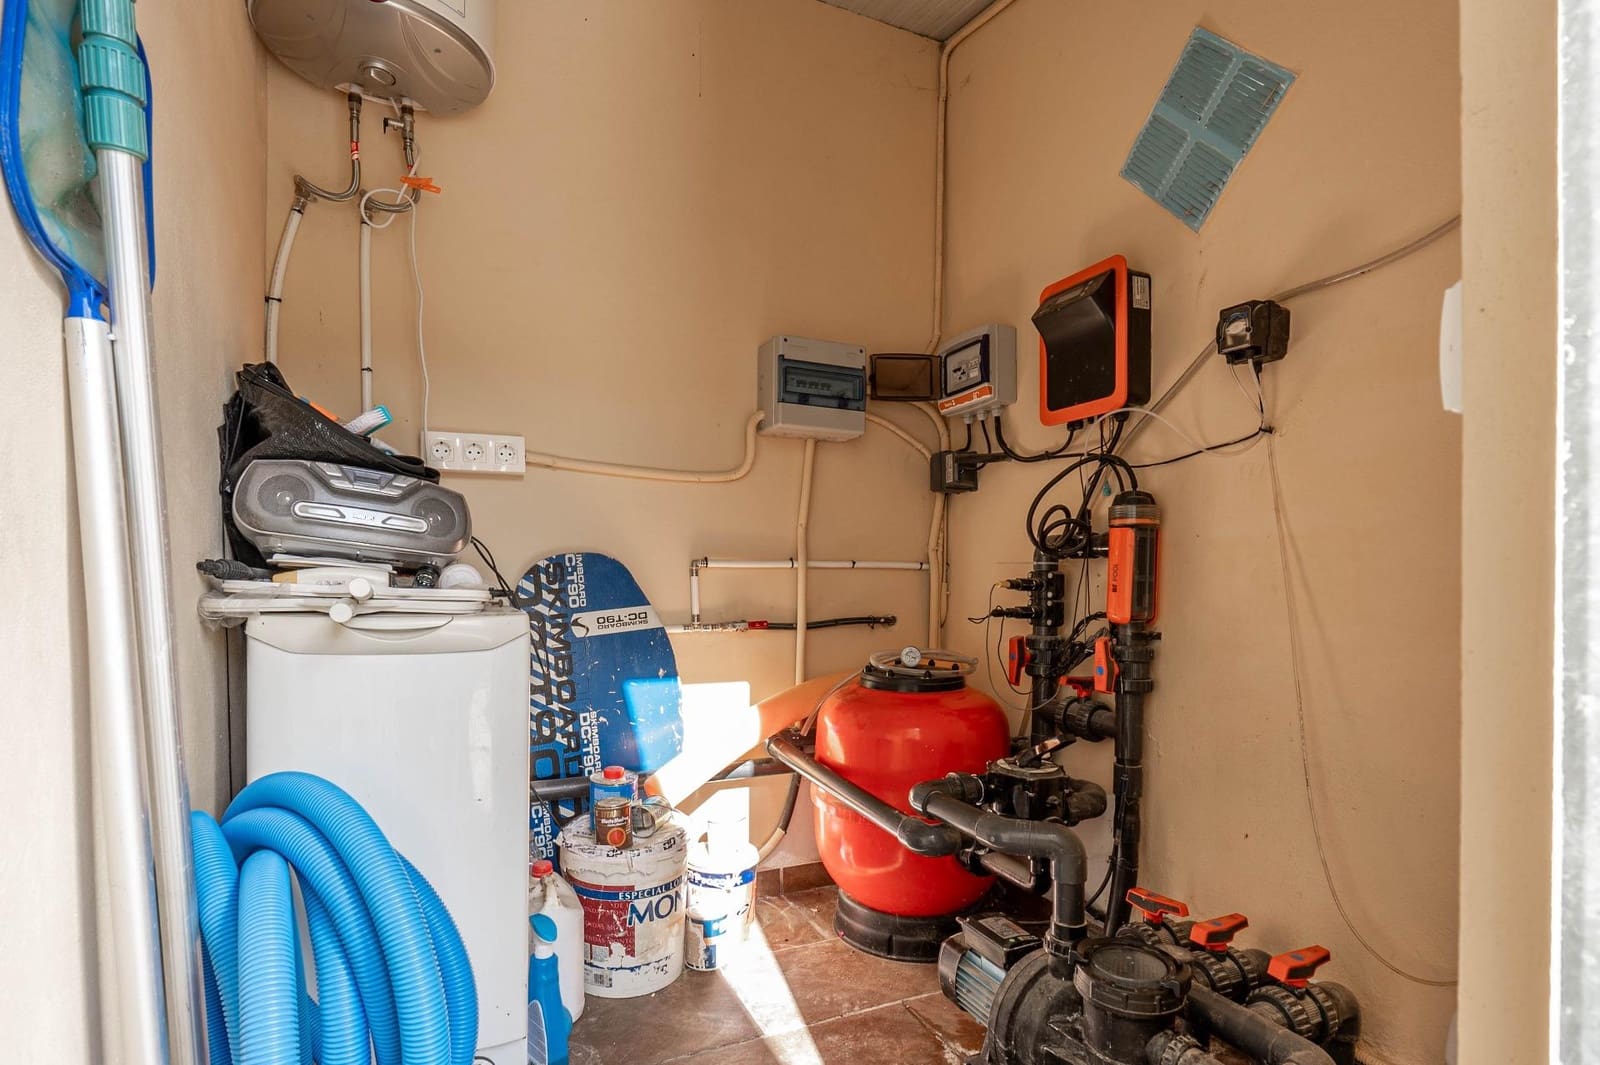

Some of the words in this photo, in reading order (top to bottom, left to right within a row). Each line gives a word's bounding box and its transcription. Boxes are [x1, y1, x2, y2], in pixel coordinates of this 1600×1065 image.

[597, 619, 649, 630] SKIMBOARD
[545, 562, 582, 778] SKIMBOARD
[618, 885, 667, 901] ESPECIAL
